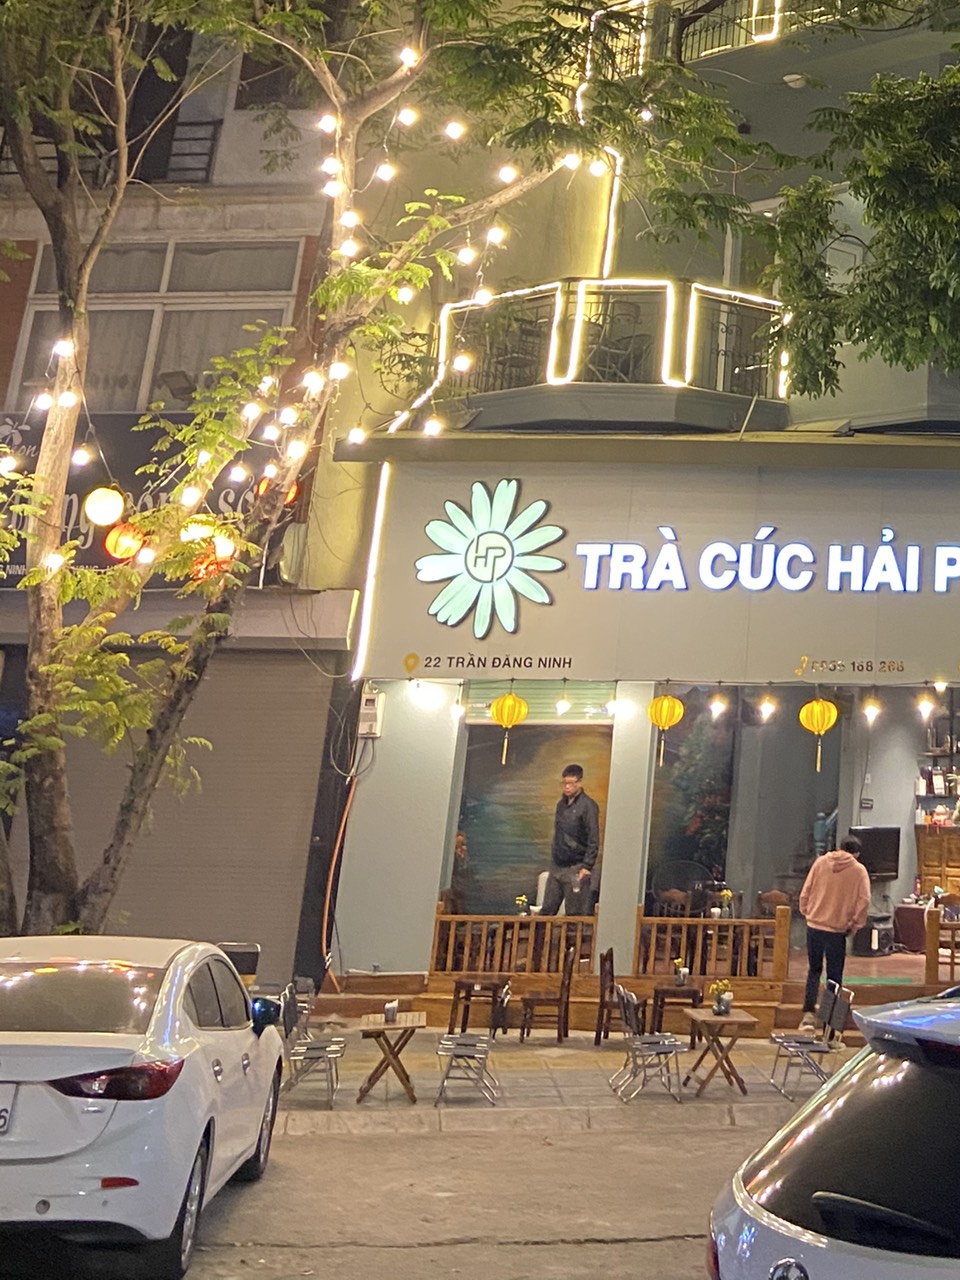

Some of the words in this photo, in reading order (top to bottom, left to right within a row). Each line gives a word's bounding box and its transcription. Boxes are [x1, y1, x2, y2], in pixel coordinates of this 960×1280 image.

[575, 526, 688, 590] TRÀ
[698, 526, 815, 591] CÚC
[826, 526, 921, 592] HẢI
[424, 657, 441, 668] 22
[447, 652, 487, 668] TRẦN
[538, 657, 572, 669] NINH
